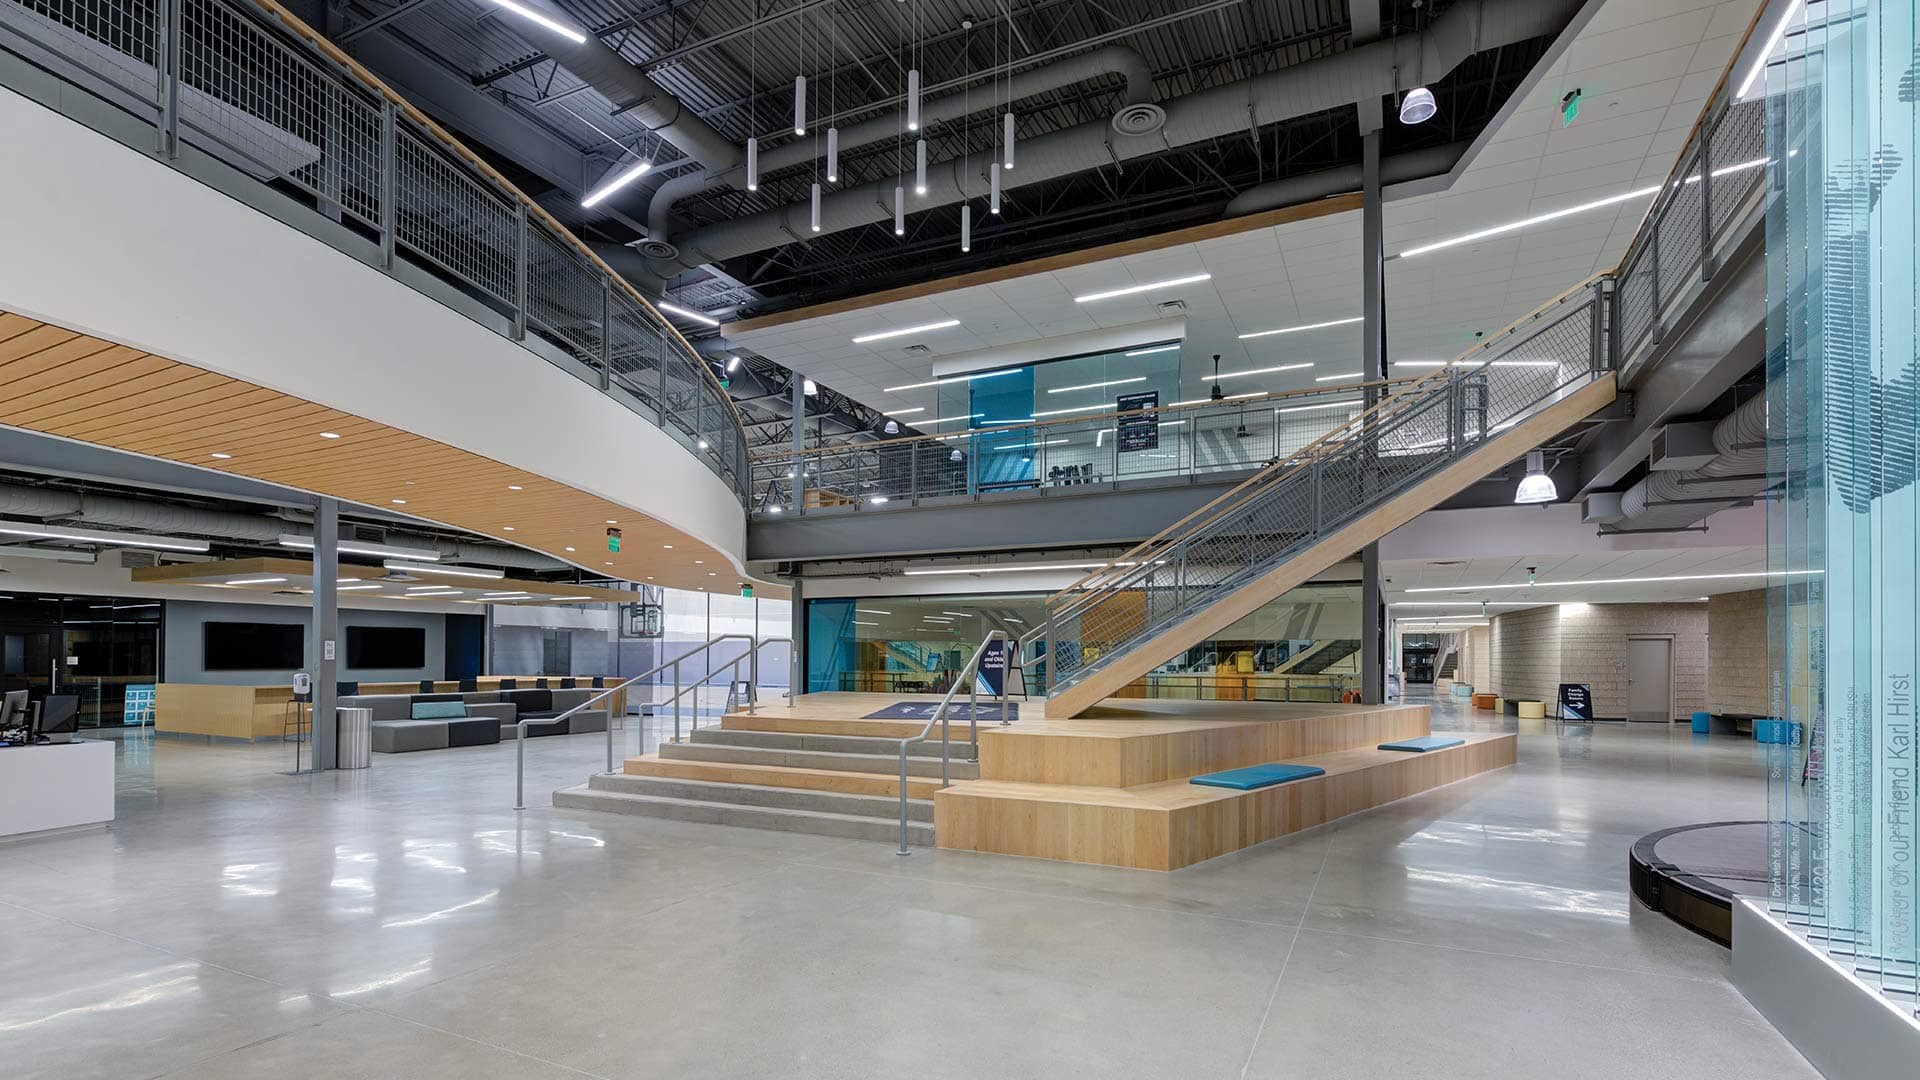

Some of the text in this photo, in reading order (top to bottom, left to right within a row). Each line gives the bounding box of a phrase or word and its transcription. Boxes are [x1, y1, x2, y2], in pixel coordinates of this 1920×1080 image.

[1887, 673, 1909, 717] Hirst
[1887, 723, 1909, 760] Karl
[1887, 767, 1909, 825] Friend
